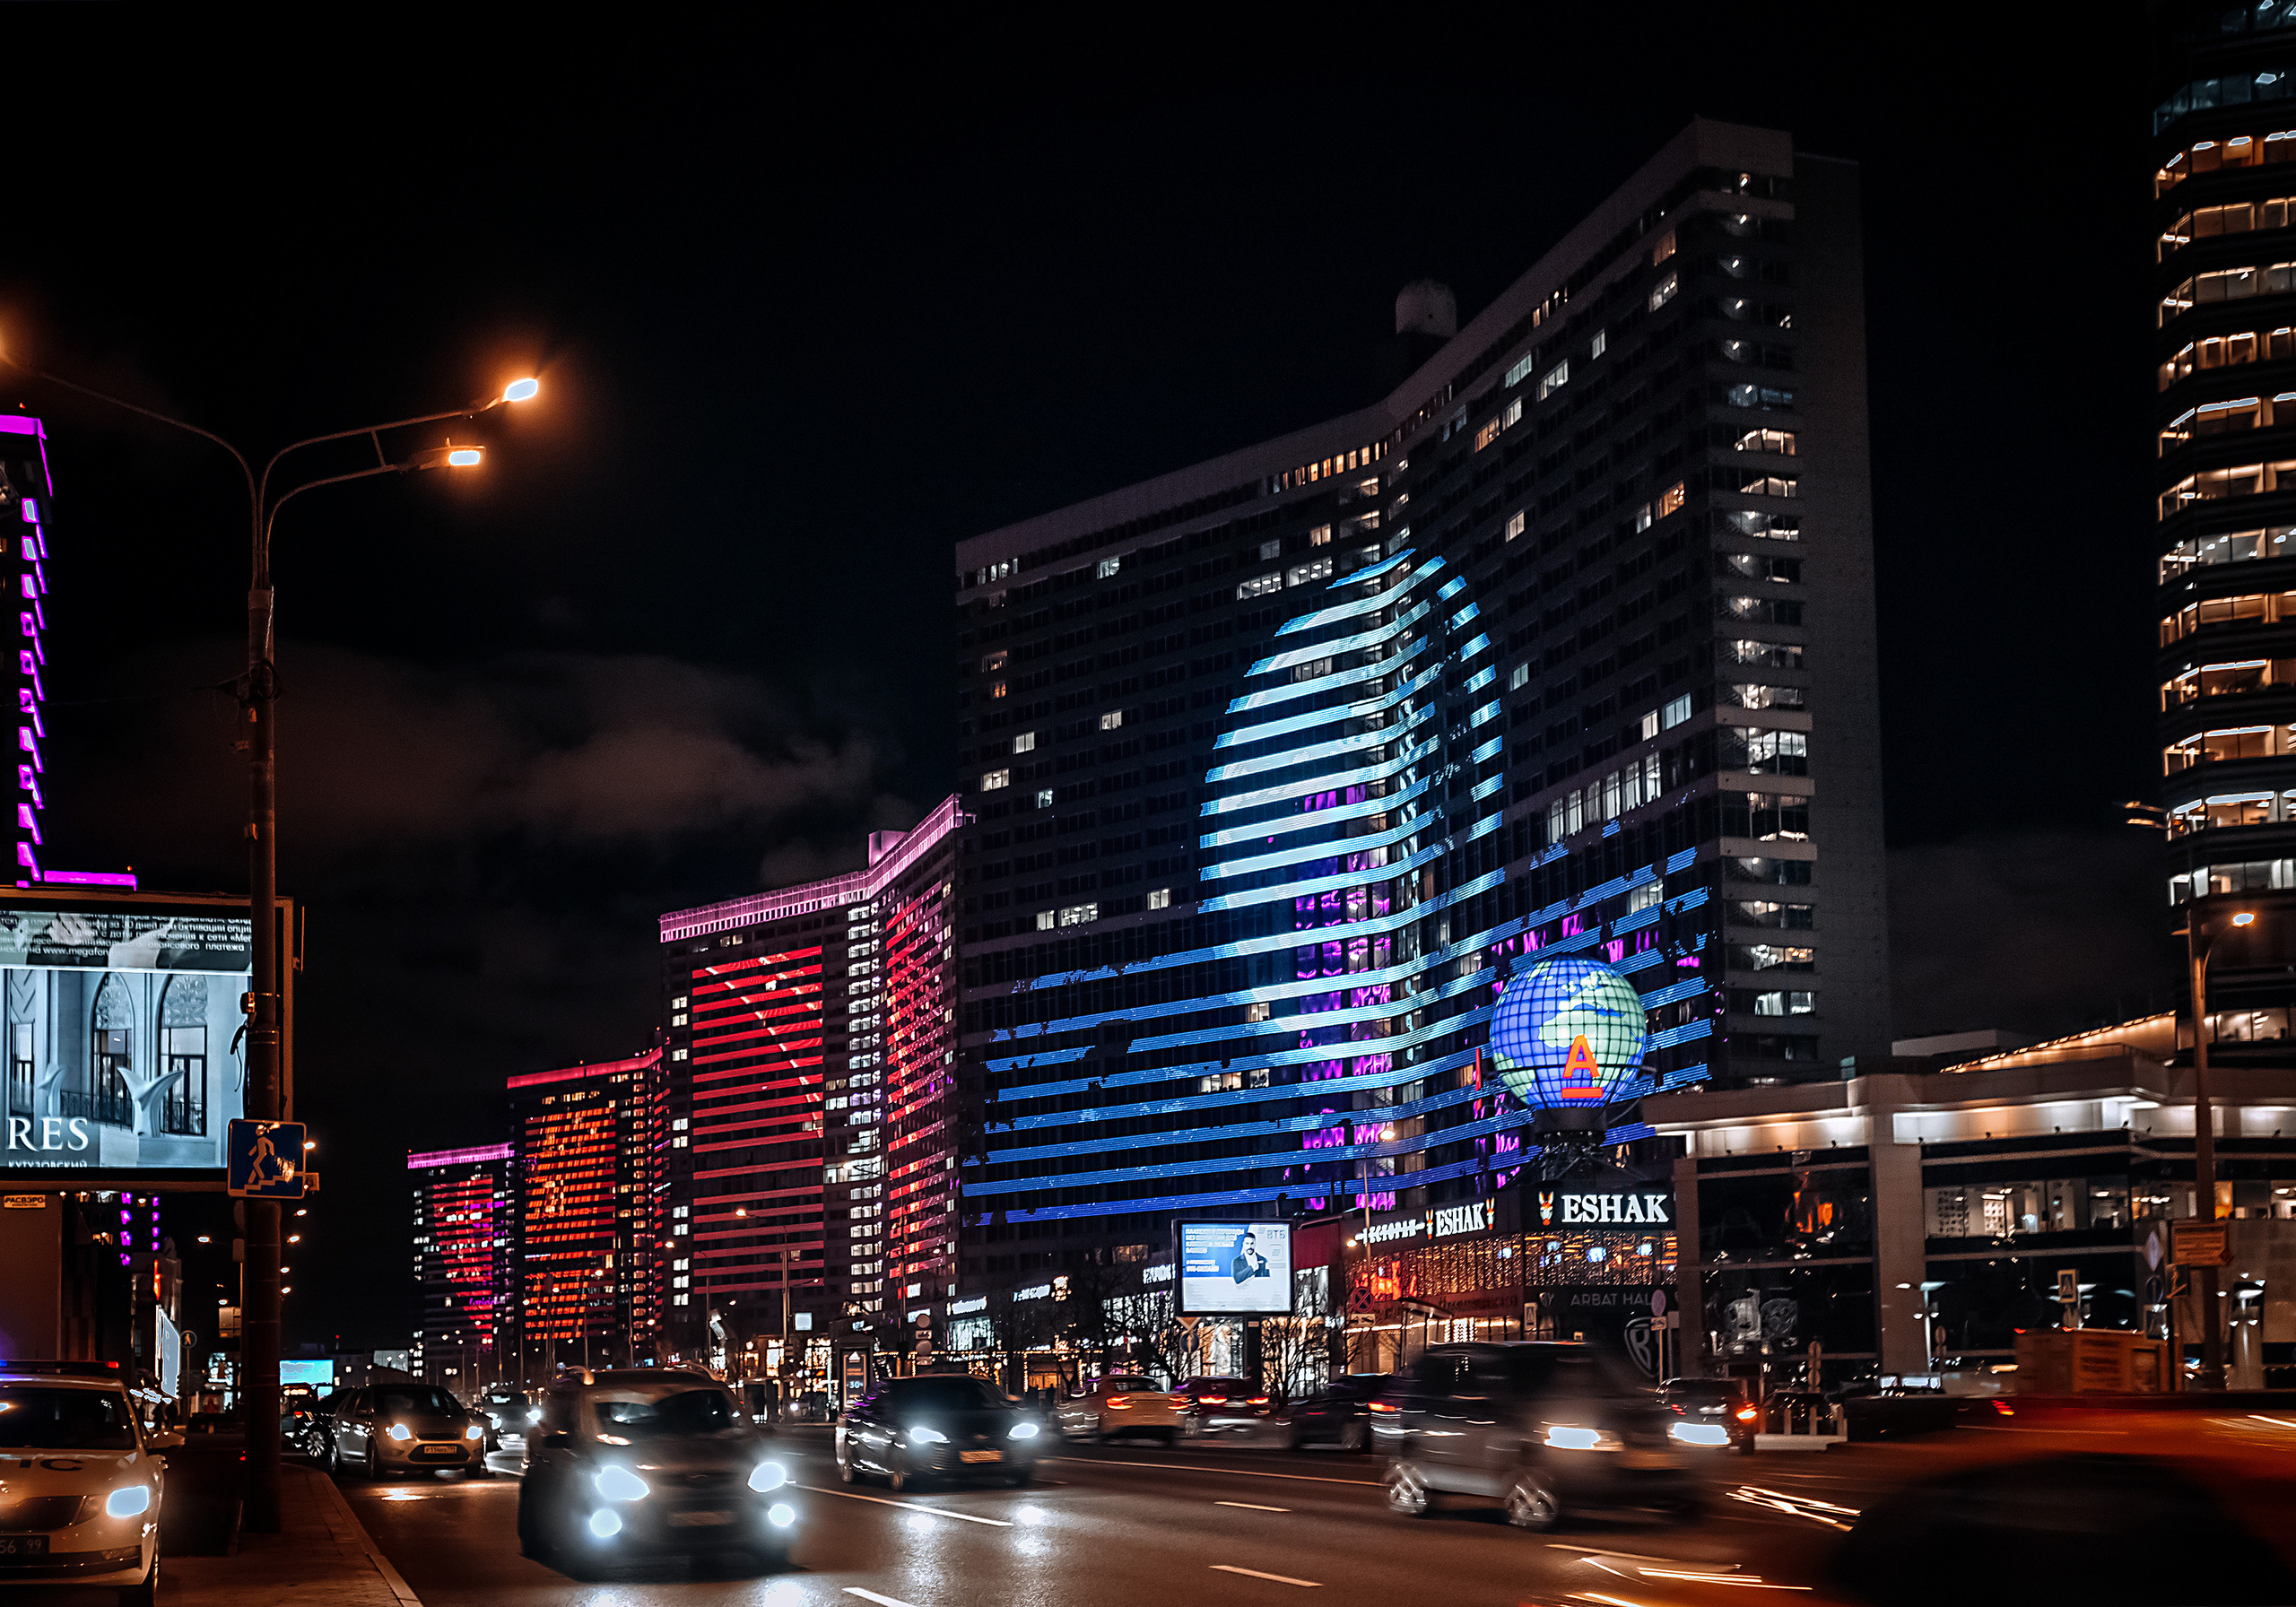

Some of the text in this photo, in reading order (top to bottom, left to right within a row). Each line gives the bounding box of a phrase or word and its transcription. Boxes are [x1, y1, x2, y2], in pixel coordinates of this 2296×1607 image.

[205, 943, 245, 951] платежа
[1561, 1194, 1670, 1223] ESHAK
[1435, 1203, 1485, 1237] ESHAK
[1266, 1229, 1286, 1240] ВТБ
[1570, 1293, 1618, 1307] ARBAT
[1622, 1292, 1652, 1305] HAL
[26, 1539, 41, 1551] 99
